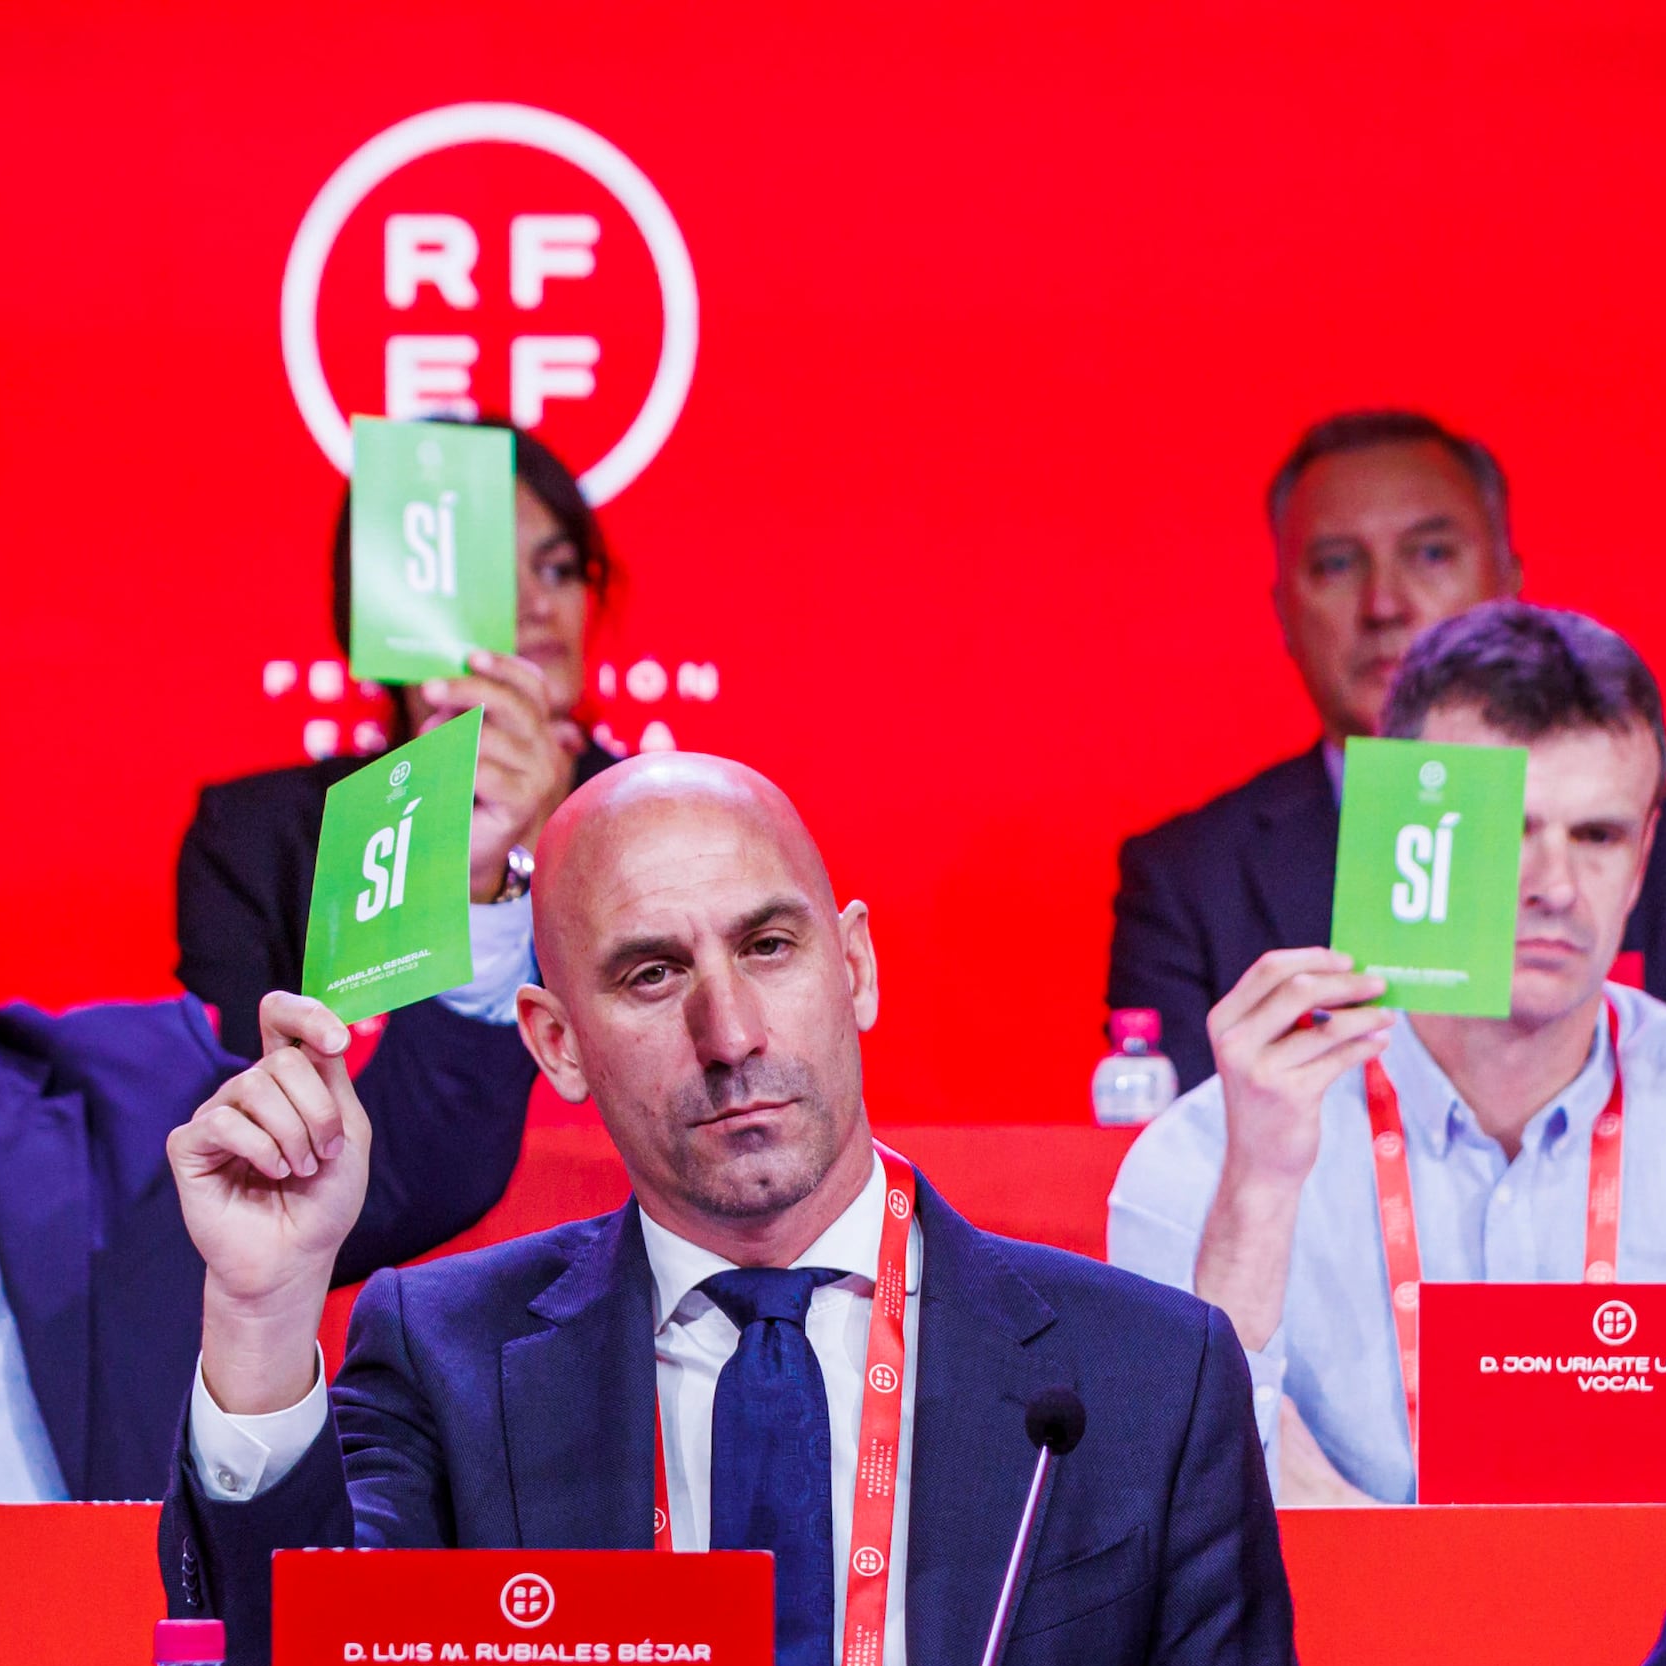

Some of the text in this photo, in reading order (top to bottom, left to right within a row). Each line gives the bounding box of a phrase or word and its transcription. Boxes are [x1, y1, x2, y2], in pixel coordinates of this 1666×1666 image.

[403, 490, 458, 598] SÍ
[355, 796, 423, 923] SÍ
[1391, 811, 1462, 923] SÍ
[326, 948, 432, 992] ASAMBLEA GENERAL
[1480, 1356, 1500, 1374] D.
[1502, 1356, 1552, 1374] JON
[1555, 1356, 1651, 1374] URIARTE
[1577, 1375, 1654, 1392] VOCAL
[344, 1638, 712, 1663] D. LUIS M. RUBIALES BÉJAR
